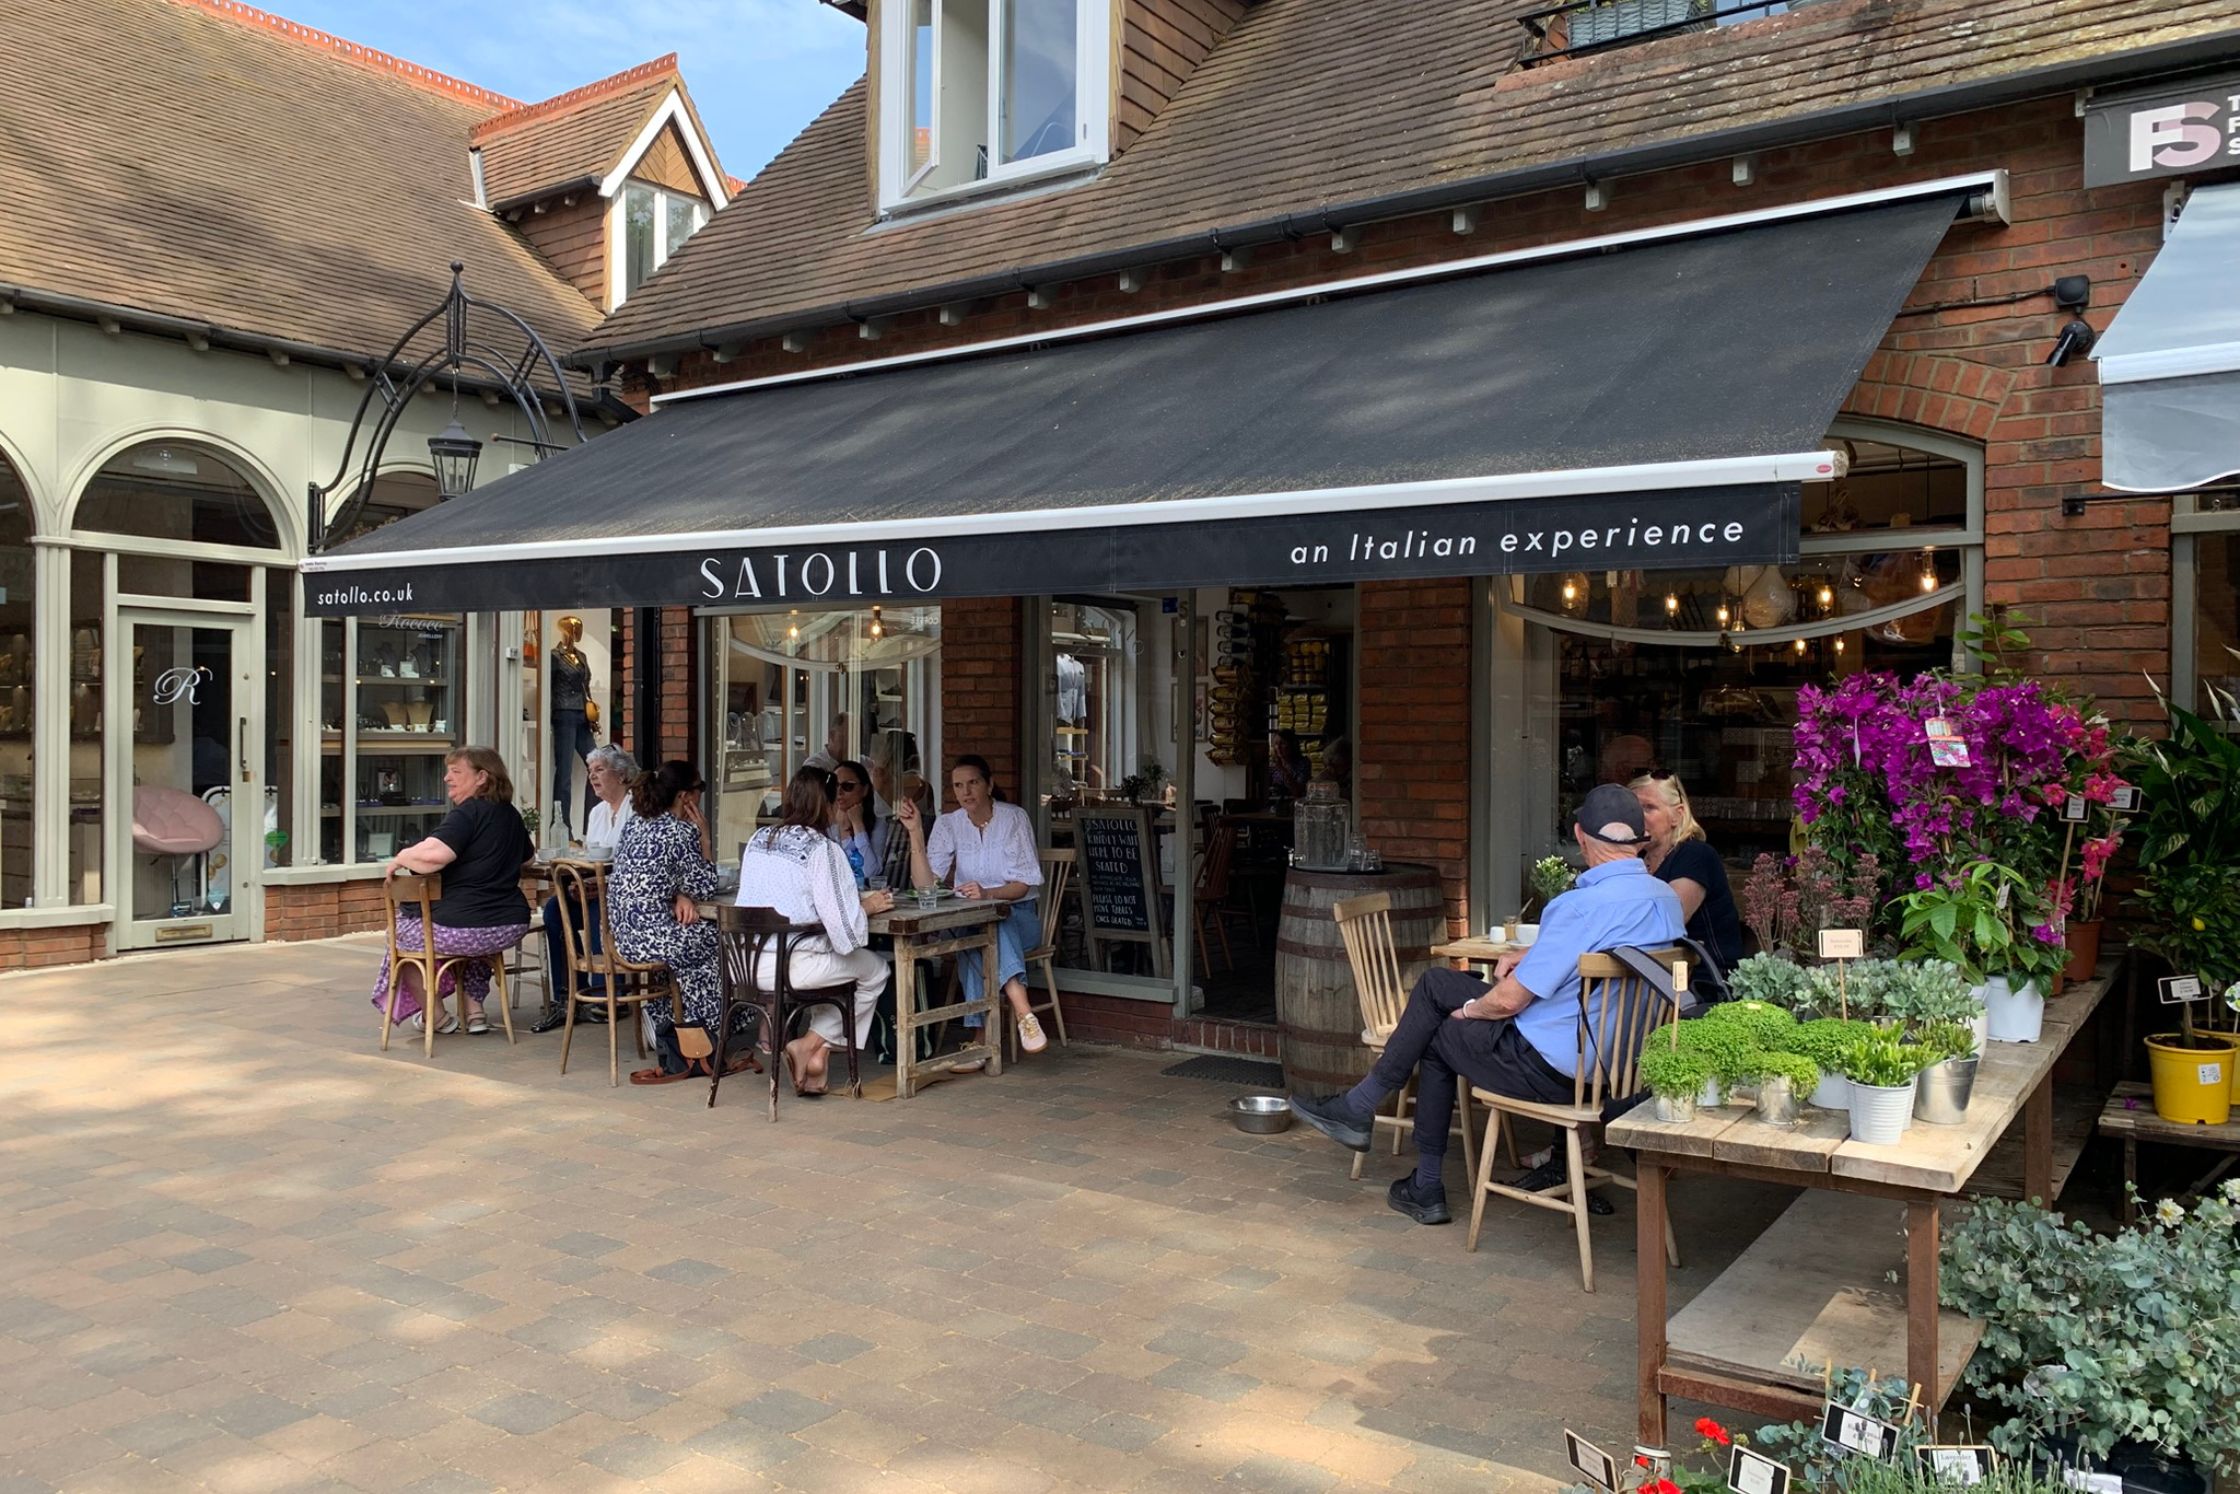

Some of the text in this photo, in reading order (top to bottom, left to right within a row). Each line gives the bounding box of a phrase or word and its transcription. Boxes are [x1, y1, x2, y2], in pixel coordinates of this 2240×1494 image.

[2129, 101, 2221, 172] FS
[1290, 517, 1744, 564] an Italian experience
[700, 547, 942, 598] SATOLLO
[317, 582, 414, 606] satollo.co.uk
[378, 613, 443, 632] Rococo
[153, 666, 213, 706] R
[1111, 847, 1123, 859] TO
